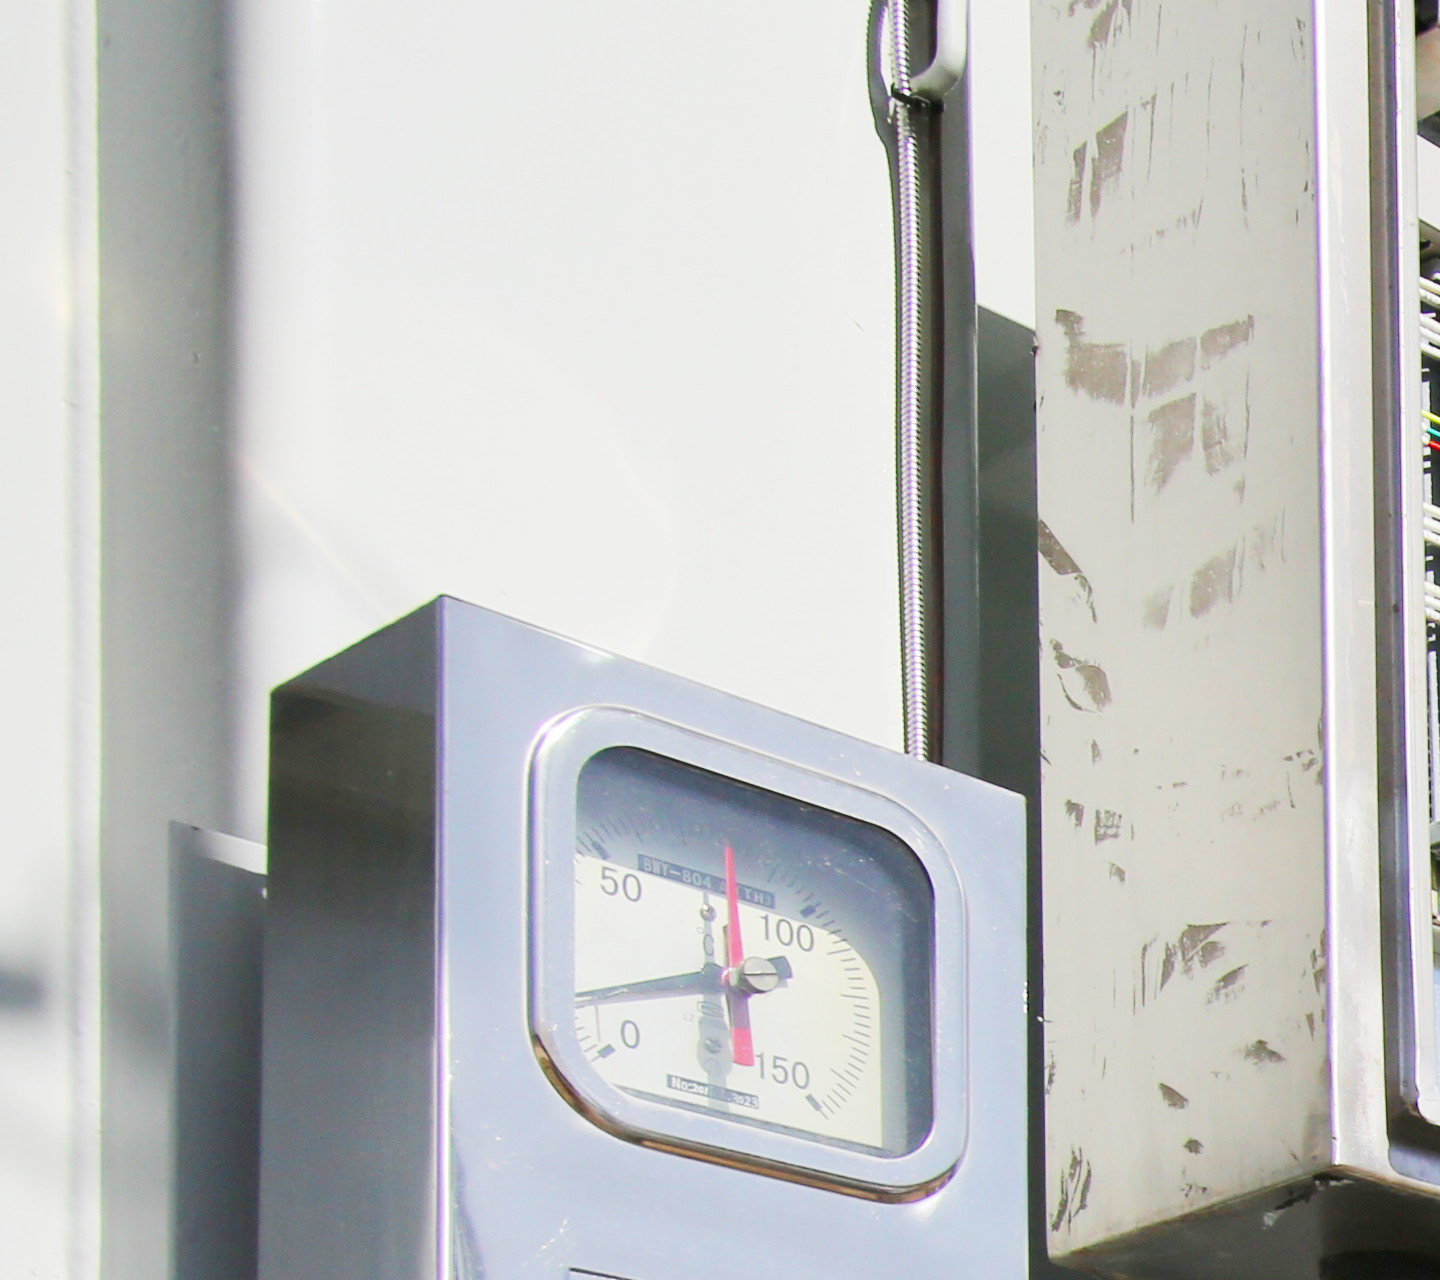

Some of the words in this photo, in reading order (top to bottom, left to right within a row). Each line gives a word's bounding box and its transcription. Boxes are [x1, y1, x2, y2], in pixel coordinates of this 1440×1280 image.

[600, 866, 642, 903] 50
[759, 913, 815, 953] 100
[620, 1020, 640, 1049] 0
[755, 1052, 810, 1090] 150
